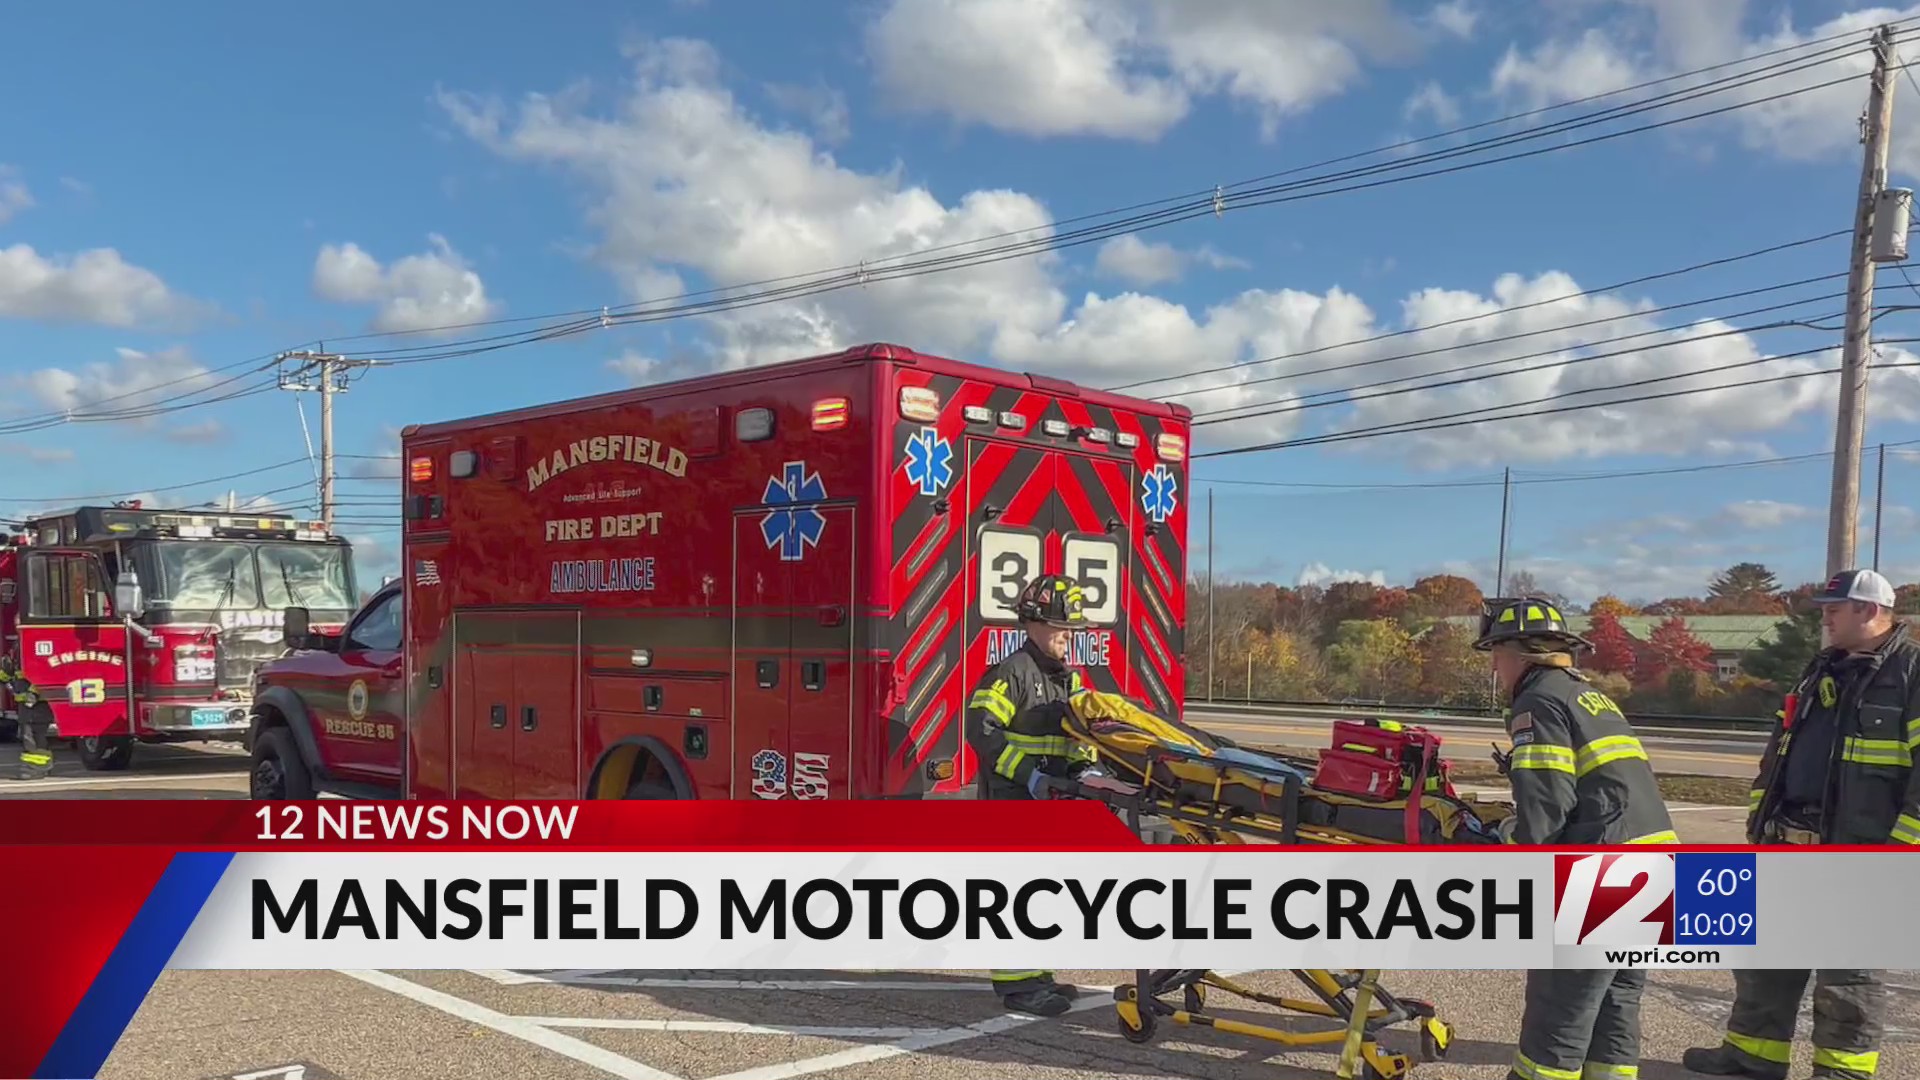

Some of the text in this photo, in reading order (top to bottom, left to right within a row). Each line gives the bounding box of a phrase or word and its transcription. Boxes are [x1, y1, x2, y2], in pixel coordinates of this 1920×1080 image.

[526, 435, 688, 492] MANSFIELD
[545, 511, 663, 542] FIRE DEPT
[550, 556, 655, 593] AMBULANCE
[47, 650, 124, 668] ENGINE
[66, 678, 106, 704] 13
[325, 718, 376, 738] RESCUE
